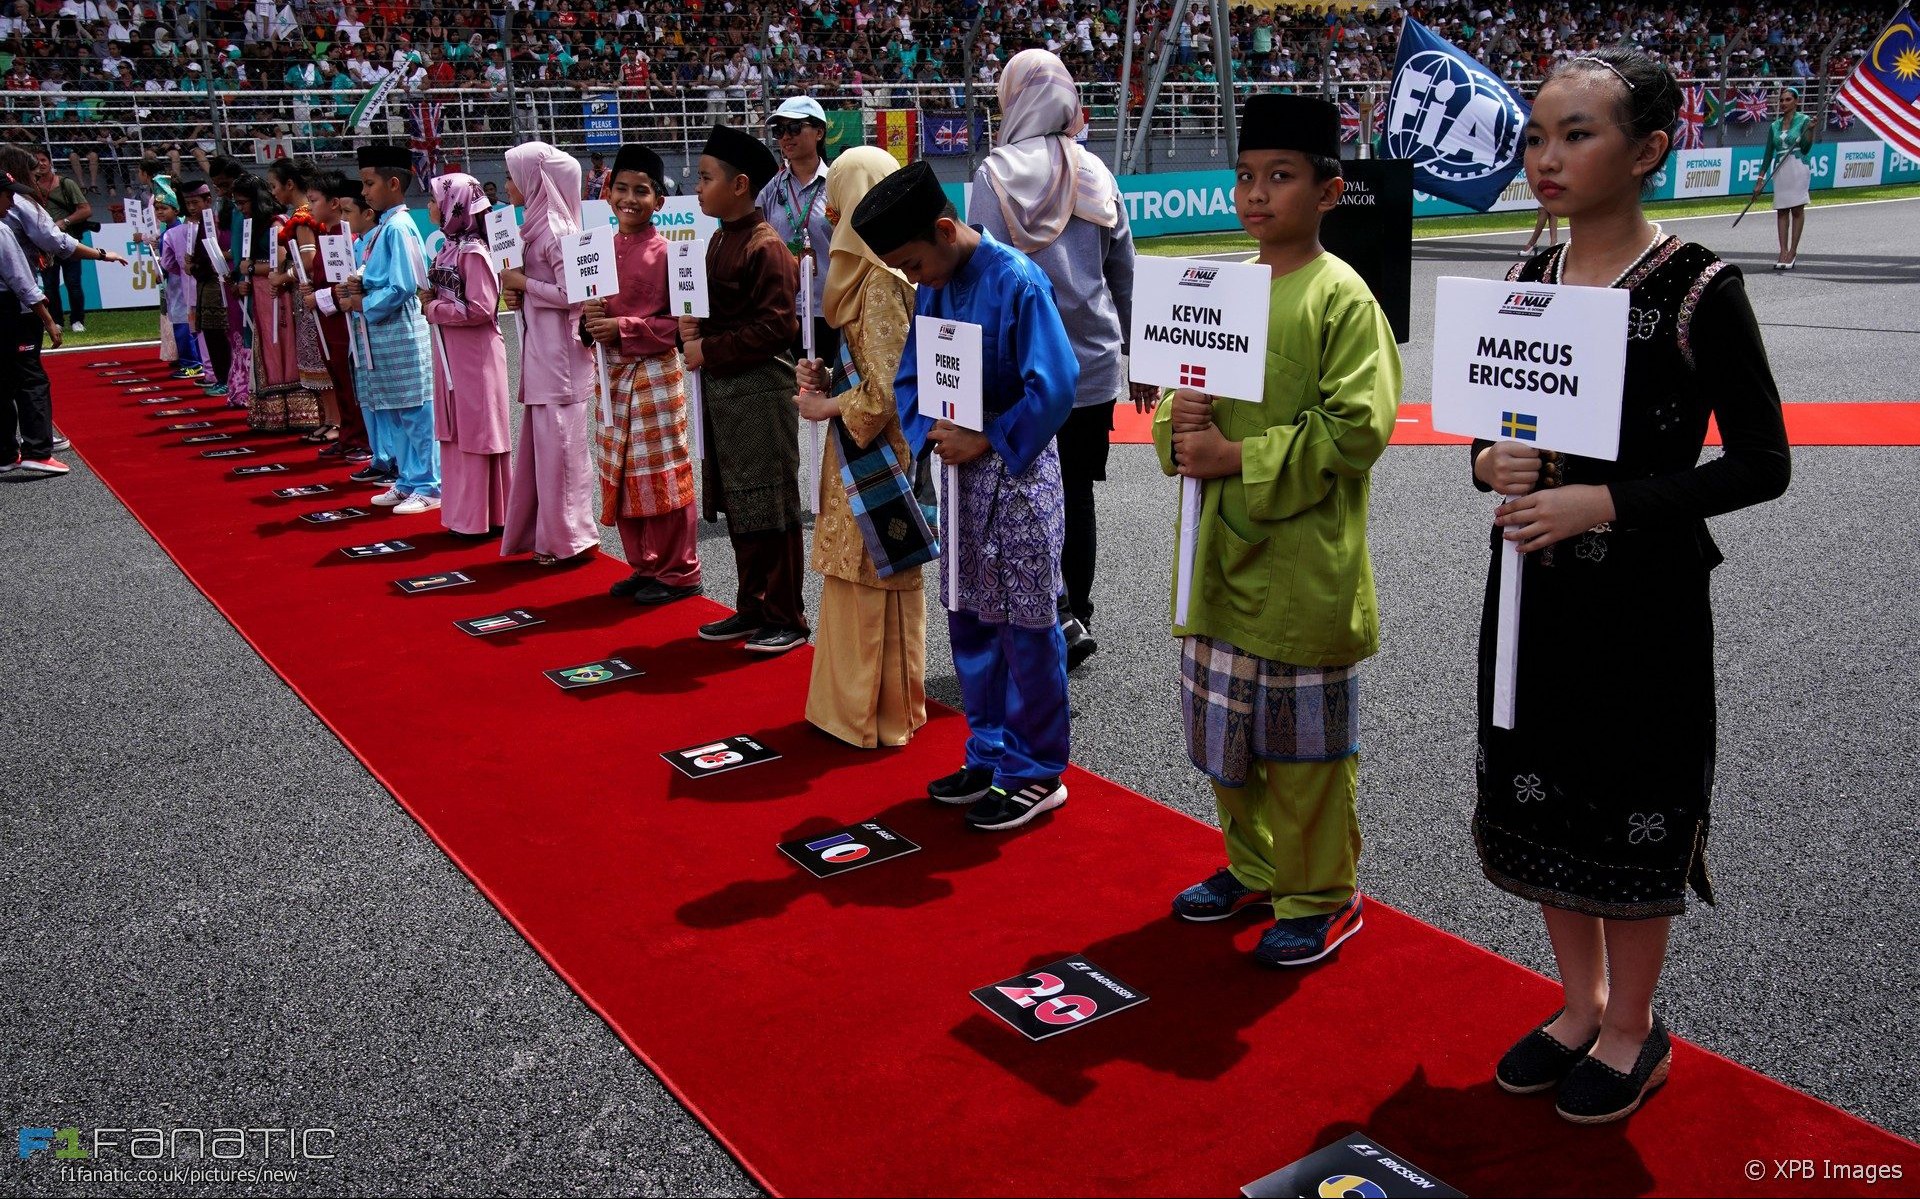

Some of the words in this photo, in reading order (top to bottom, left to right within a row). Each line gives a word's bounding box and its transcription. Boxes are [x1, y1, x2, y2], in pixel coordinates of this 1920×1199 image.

[591, 120, 612, 129] PLEASE
[263, 144, 286, 159] 1A
[1845, 152, 1875, 160] PETRONAS
[1686, 159, 1721, 168] PETRONAS
[1343, 181, 1366, 192] OYAL
[1337, 194, 1375, 205] LANGOR
[577, 253, 599, 266] SERGIO
[580, 266, 598, 277] PEREZ
[679, 268, 692, 277] FELIPE
[679, 281, 694, 291] MASSA
[1172, 304, 1221, 326] KEVIN
[1144, 324, 1249, 353] MAGNUSSEN
[1477, 336, 1573, 366] MARCUS
[936, 353, 960, 371] PIERRE
[936, 371, 960, 389] GASLY
[1469, 363, 1579, 397] ERICSSON
[680, 742, 744, 769] 18
[805, 833, 871, 863] 10
[1087, 972, 1136, 999] MAGNUSSEN
[995, 972, 1098, 1025] 20
[1377, 1158, 1435, 1189] ERICSSON
